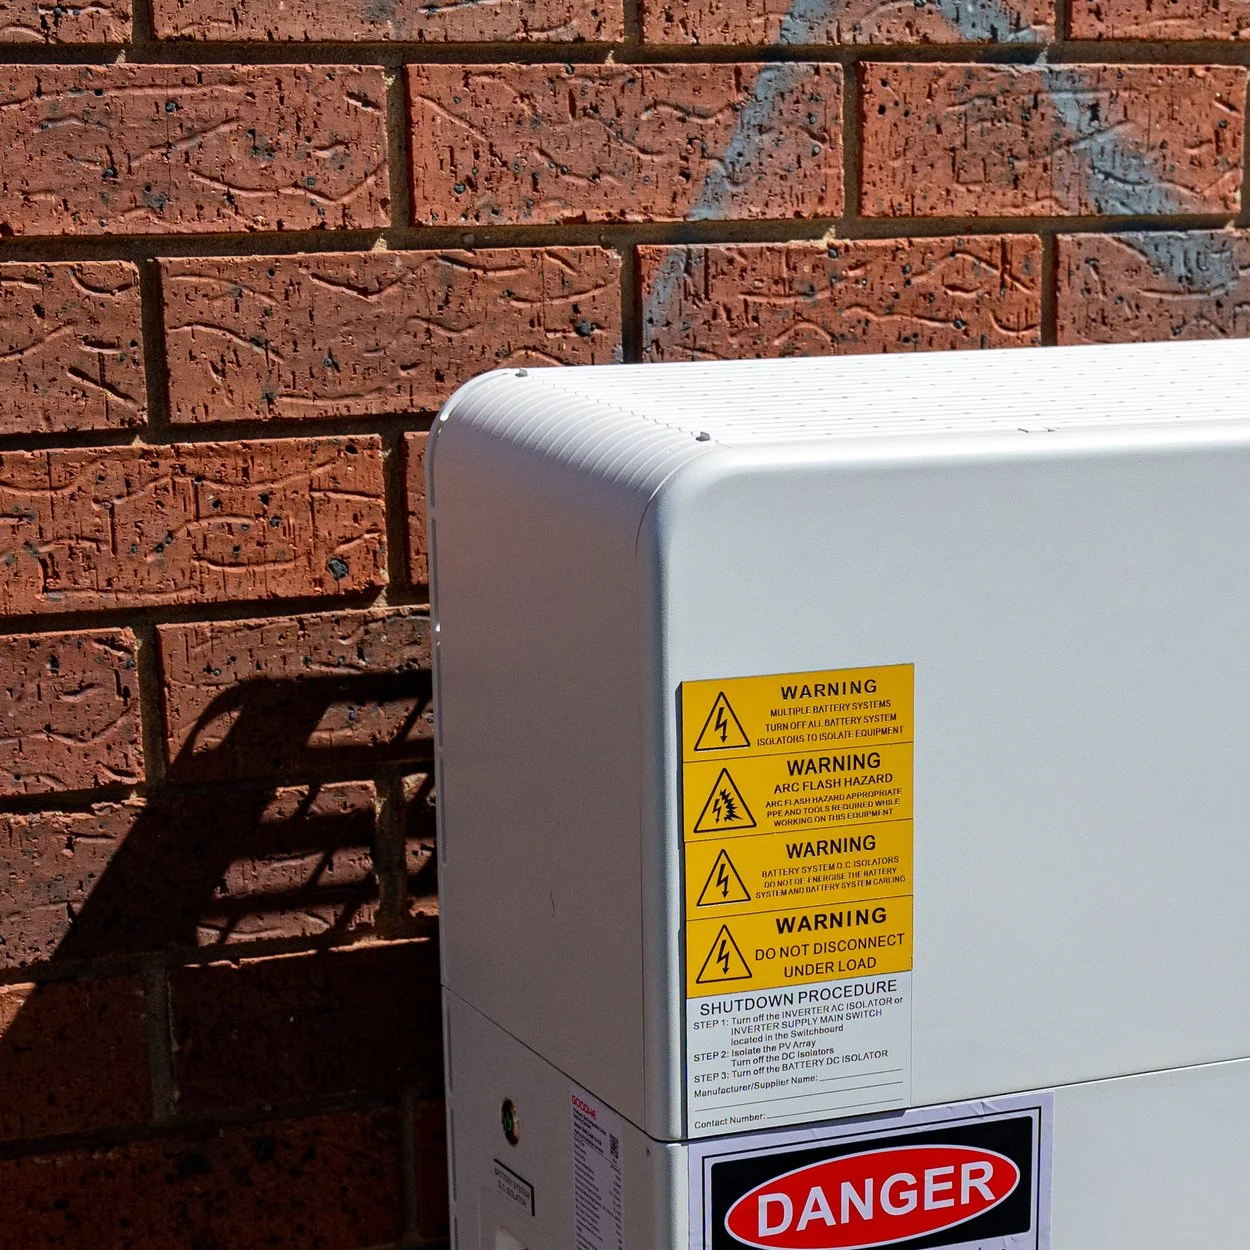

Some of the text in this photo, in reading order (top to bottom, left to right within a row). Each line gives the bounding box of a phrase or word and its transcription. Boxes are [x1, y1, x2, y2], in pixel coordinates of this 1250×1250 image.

[781, 679, 877, 700] WARNING
[771, 700, 891, 717] MULTIPLE BATTERY SYSTEMS
[766, 714, 896, 732] TURN OFF ALL BATTERY SYSTEM
[757, 726, 904, 746] ISOLATORS TO ISOLATE EQUIPMENT
[787, 752, 881, 776] WARNING
[774, 774, 893, 794] ARC FLASH HAZARD
[766, 788, 902, 808] ARC FLASH HAZARD APPROPRIATE
[767, 798, 900, 818] PPE AND TOOLS REQUIRED WHILE
[774, 817, 811, 827] WORKING
[828, 814, 845, 822] THIS
[847, 809, 893, 819] EQUIPMENT
[786, 835, 876, 859] WARNING
[762, 868, 799, 878] BATTERY
[801, 865, 835, 873] SYSTEM
[853, 856, 899, 867] ISOLATORS
[864, 867, 897, 877] BATTERY
[755, 890, 788, 898] SYSTEM
[806, 884, 839, 893] BATTERY
[841, 880, 871, 889] SYSTEM
[873, 875, 906, 885] CABLING
[776, 907, 887, 934] WARNING
[755, 933, 905, 961] DO NOT DISCONNECT
[784, 957, 876, 978] UNDER LOAD
[700, 979, 897, 1016] SHUTDOWN PROCEDURE
[693, 1020, 718, 1030] STEP
[722, 1018, 728, 1027] 1:
[731, 1015, 751, 1025] Turn
[753, 1013, 765, 1022] off
[766, 1012, 780, 1020] the
[782, 1005, 829, 1018] INVERTER
[832, 1003, 844, 1012] AC
[846, 997, 892, 1010] ISOLATOR
[731, 1008, 882, 1036] INVERTER SUPPLY MAIN SWITCH
[731, 1023, 844, 1046] located in the Switchboard
[694, 1039, 816, 1062] STEP 2: Isolate the PV Array
[731, 1046, 834, 1068] Turn off the DC Isolators
[694, 1049, 889, 1084] STEP 3: Turn off the BATTERY DC ISOLATOR
[694, 1074, 818, 1098] Manufacturer/Supplier Name:
[694, 1112, 766, 1129] Contact Number:
[758, 1160, 995, 1238] DANGER
